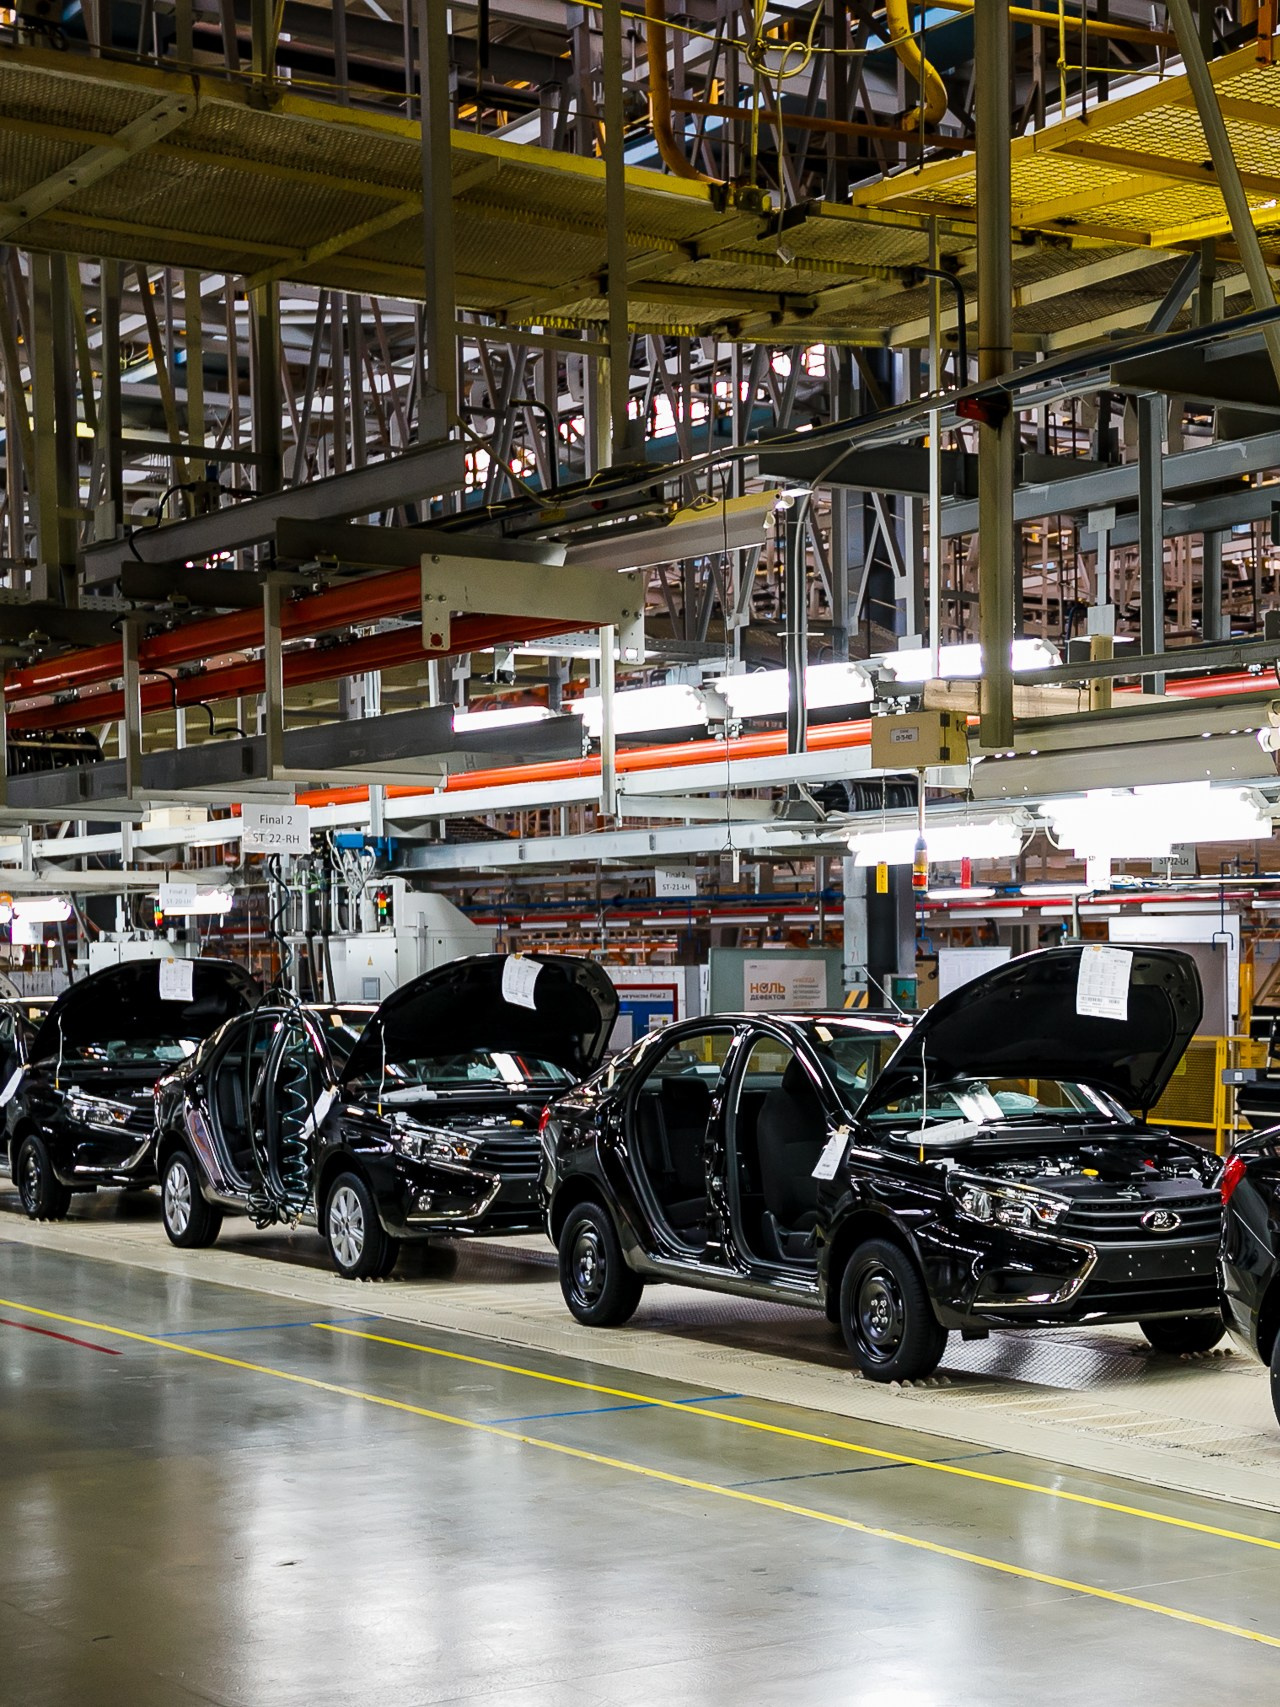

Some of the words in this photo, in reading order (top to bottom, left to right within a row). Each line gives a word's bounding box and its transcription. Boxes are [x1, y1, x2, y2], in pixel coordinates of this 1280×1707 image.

[259, 814, 284, 825] Final
[286, 815, 293, 825] 2
[750, 982, 786, 993] НОЛЬ
